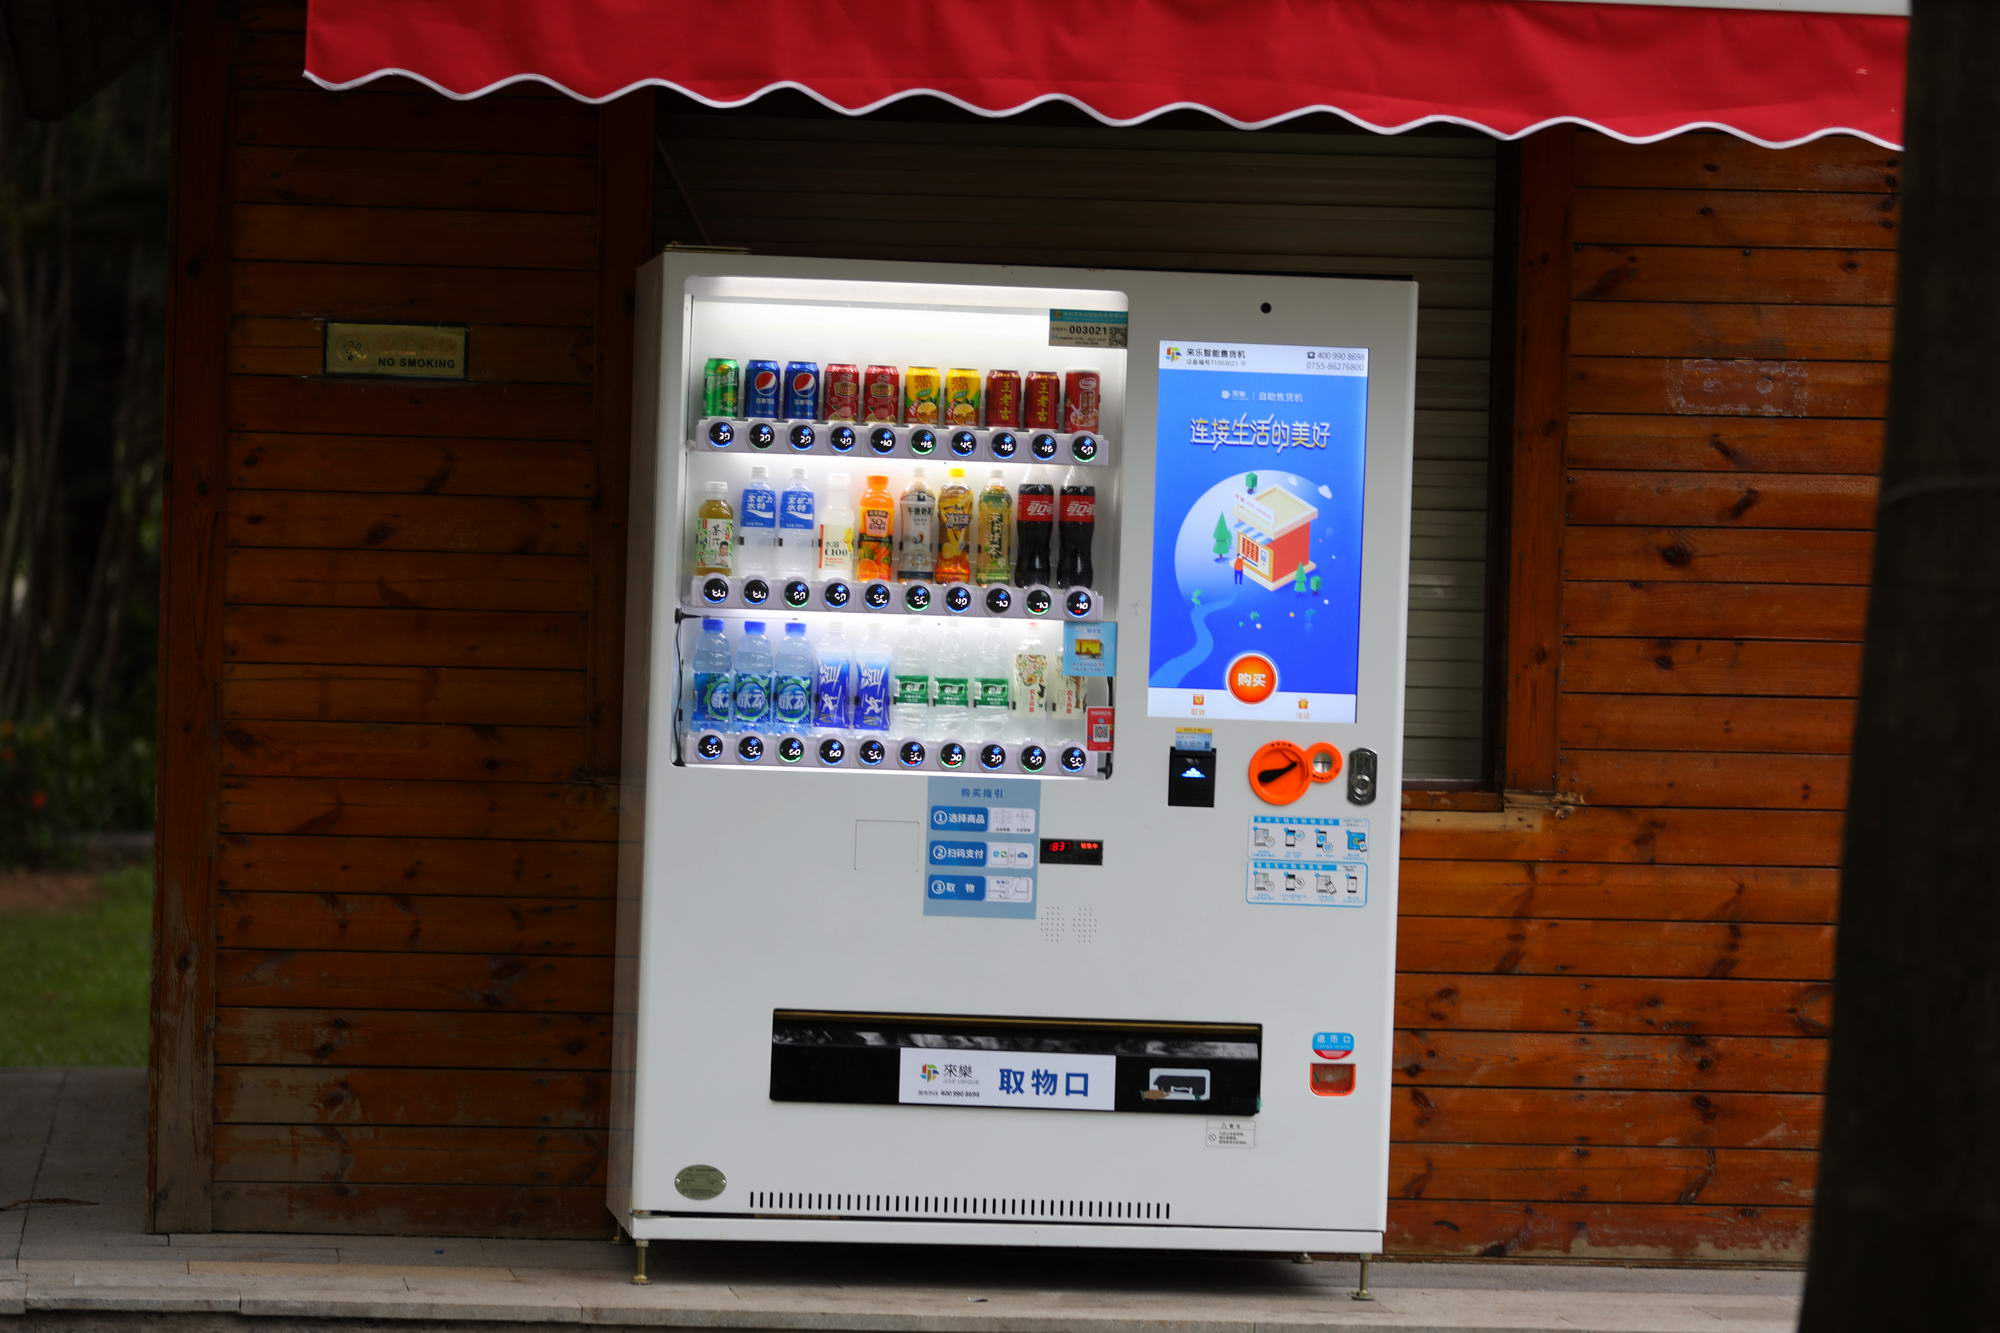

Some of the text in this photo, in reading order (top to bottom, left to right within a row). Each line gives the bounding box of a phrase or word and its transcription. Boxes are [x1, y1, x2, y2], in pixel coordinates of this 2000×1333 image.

[1069, 325, 1107, 335] 003021
[378, 357, 455, 368] NO SMOKING
[1190, 413, 1331, 453] 连接生活的美好
[1237, 672, 1266, 687] 购买
[961, 788, 1004, 798] 购买指引
[948, 813, 985, 824] 选择商品
[947, 848, 984, 859] 扫码支付
[999, 1068, 1089, 1097] 取物口
